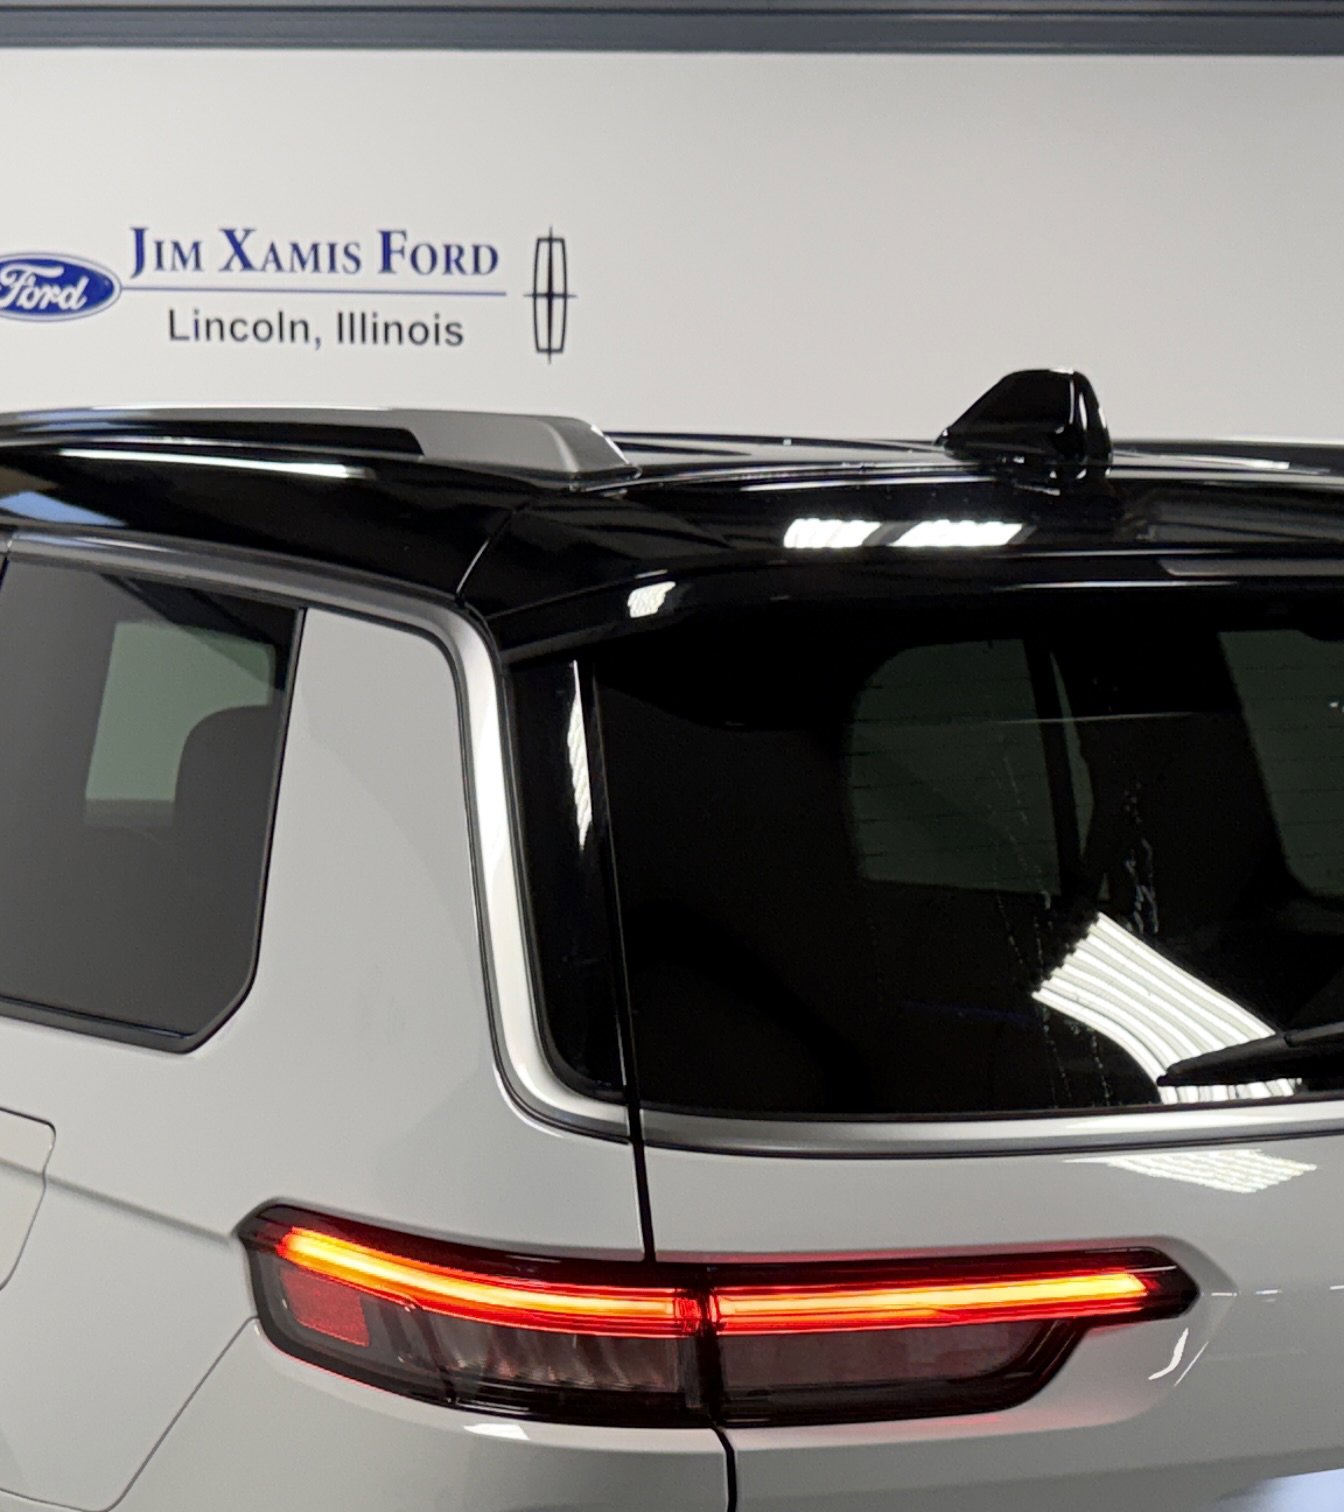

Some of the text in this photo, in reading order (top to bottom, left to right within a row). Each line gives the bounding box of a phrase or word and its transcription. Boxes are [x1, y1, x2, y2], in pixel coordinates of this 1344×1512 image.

[129, 227, 499, 277] JIM XAMIS FORD
[167, 309, 465, 351] Lincoln, Illinois
